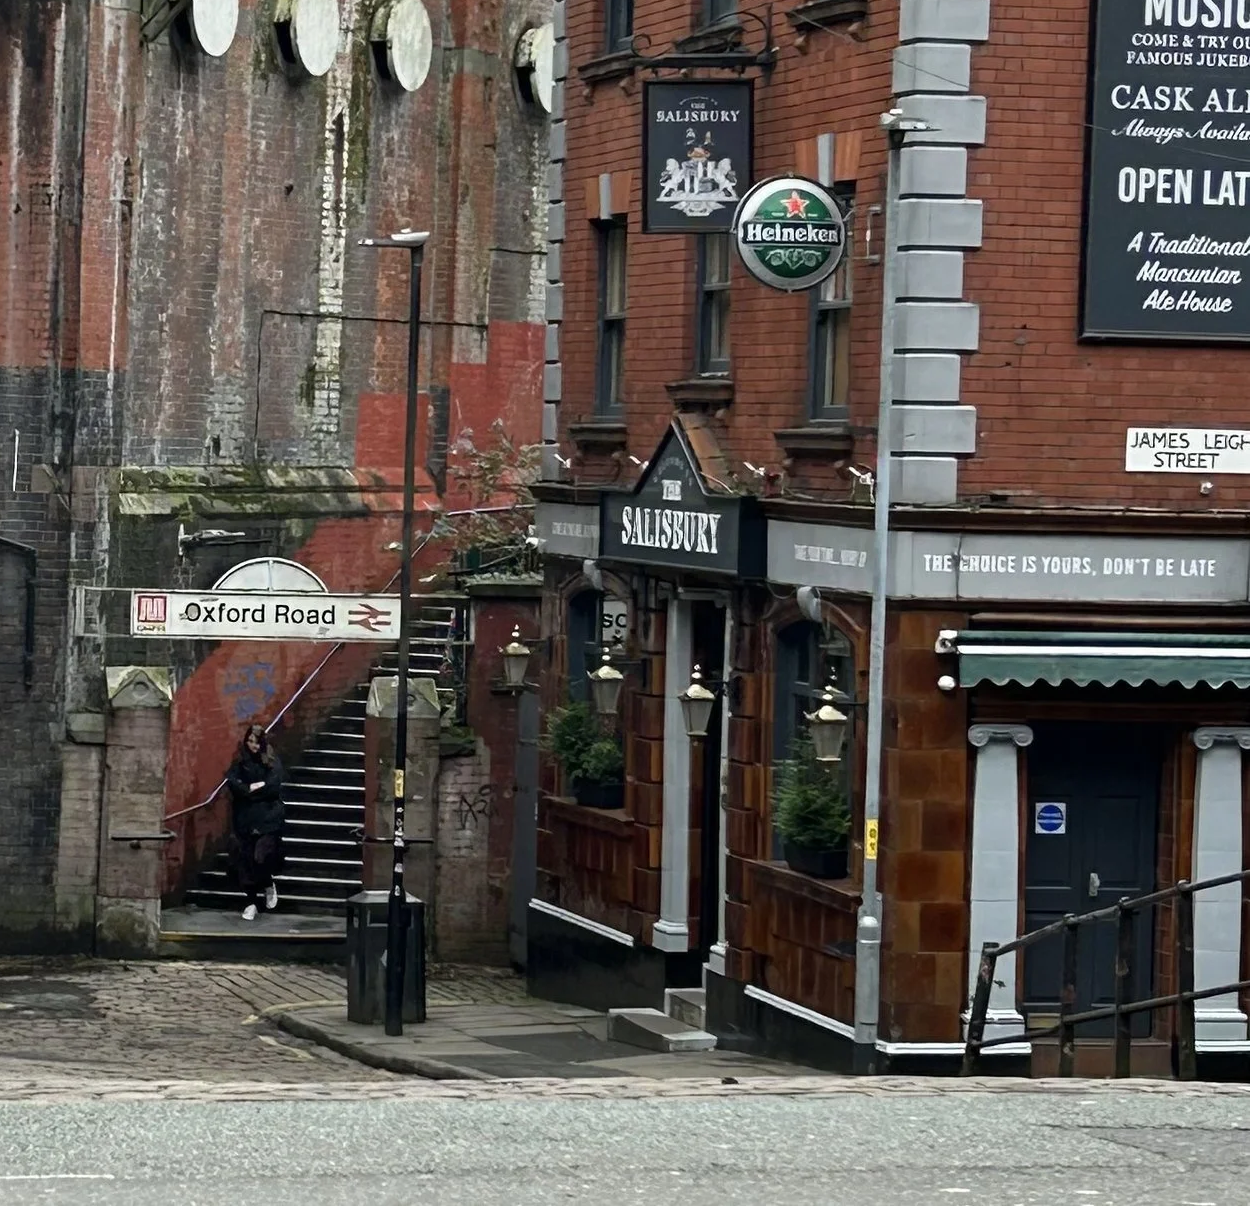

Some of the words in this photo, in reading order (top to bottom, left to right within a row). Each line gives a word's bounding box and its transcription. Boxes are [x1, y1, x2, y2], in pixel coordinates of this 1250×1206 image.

[1132, 33, 1179, 47] COME
[1182, 34, 1194, 48] &
[1197, 35, 1229, 49] TRY
[1126, 50, 1193, 65] FAMOUS
[1196, 53, 1250, 67] JUKEB
[1111, 84, 1194, 112] CASK
[656, 110, 740, 122] SALISBURY
[1186, 120, 1250, 141] Availa
[1118, 166, 1193, 204] OPEN
[1202, 170, 1250, 206] LAT
[746, 223, 839, 243] Heineken
[1127, 231, 1144, 252] A
[1148, 232, 1250, 257] Traditional
[1136, 260, 1242, 284] Mancunian
[1143, 289, 1175, 310] Ale
[1176, 289, 1233, 313] House
[1130, 432, 1190, 448] JAMES
[1154, 451, 1220, 469] STREET
[621, 506, 721, 554] SALISBURY
[924, 554, 953, 572] THE
[959, 555, 1016, 573] CHOICE
[1022, 555, 1037, 573] IS
[1042, 556, 1097, 576] YOURS,
[1103, 557, 1150, 576] DON'T
[1156, 559, 1174, 576] BE
[1181, 559, 1216, 577] LATE
[185, 602, 265, 624] Oxford
[275, 605, 336, 625] Road
